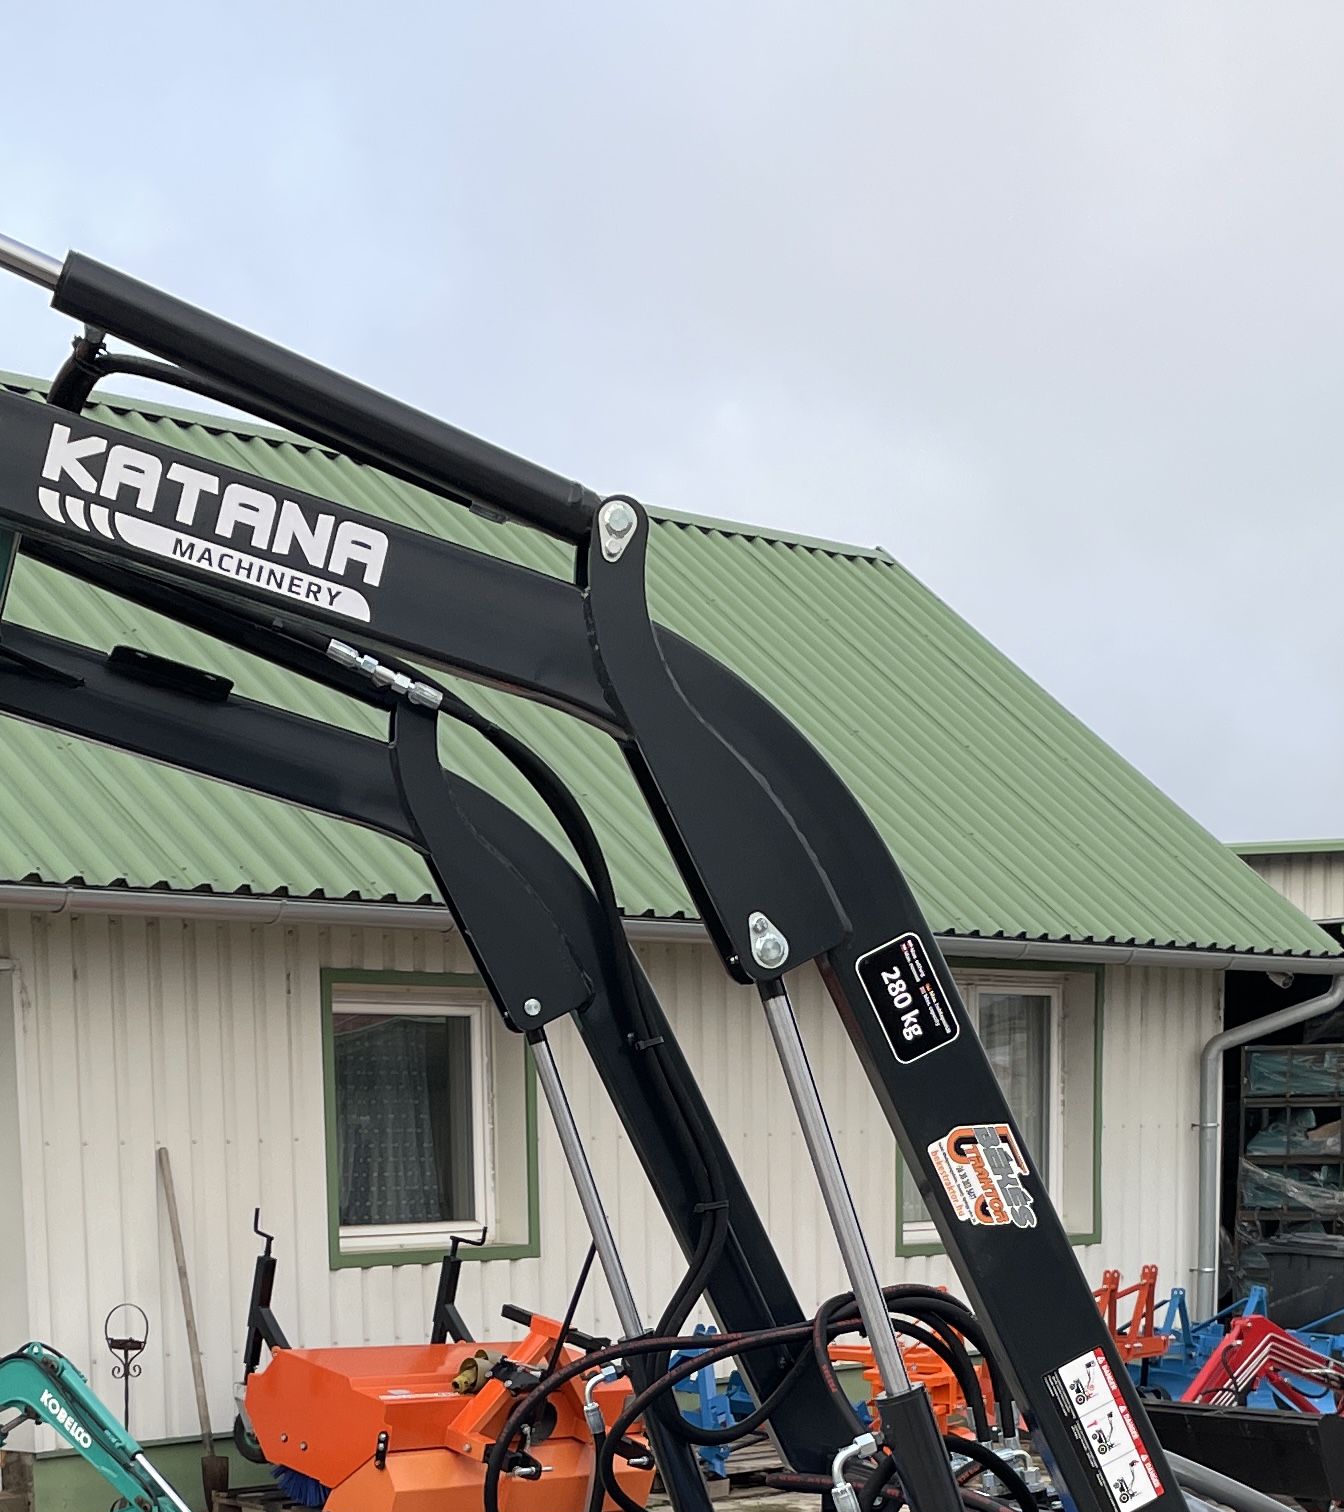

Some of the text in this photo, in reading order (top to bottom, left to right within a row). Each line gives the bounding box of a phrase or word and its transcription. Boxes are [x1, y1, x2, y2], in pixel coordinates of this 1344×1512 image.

[41, 422, 389, 588] KATANA
[171, 537, 343, 607] MACHINERY
[880, 965, 913, 1009] 280
[900, 1008, 924, 1041] kg
[964, 1143, 1010, 1223] TRAKTOR
[973, 1126, 1036, 1227] BÉKÉS
[1101, 1364, 1118, 1391] DANGER
[39, 1388, 92, 1449] KOBELCO
[1123, 1413, 1140, 1440] DANGER
[1144, 1462, 1161, 1489] DANGER
